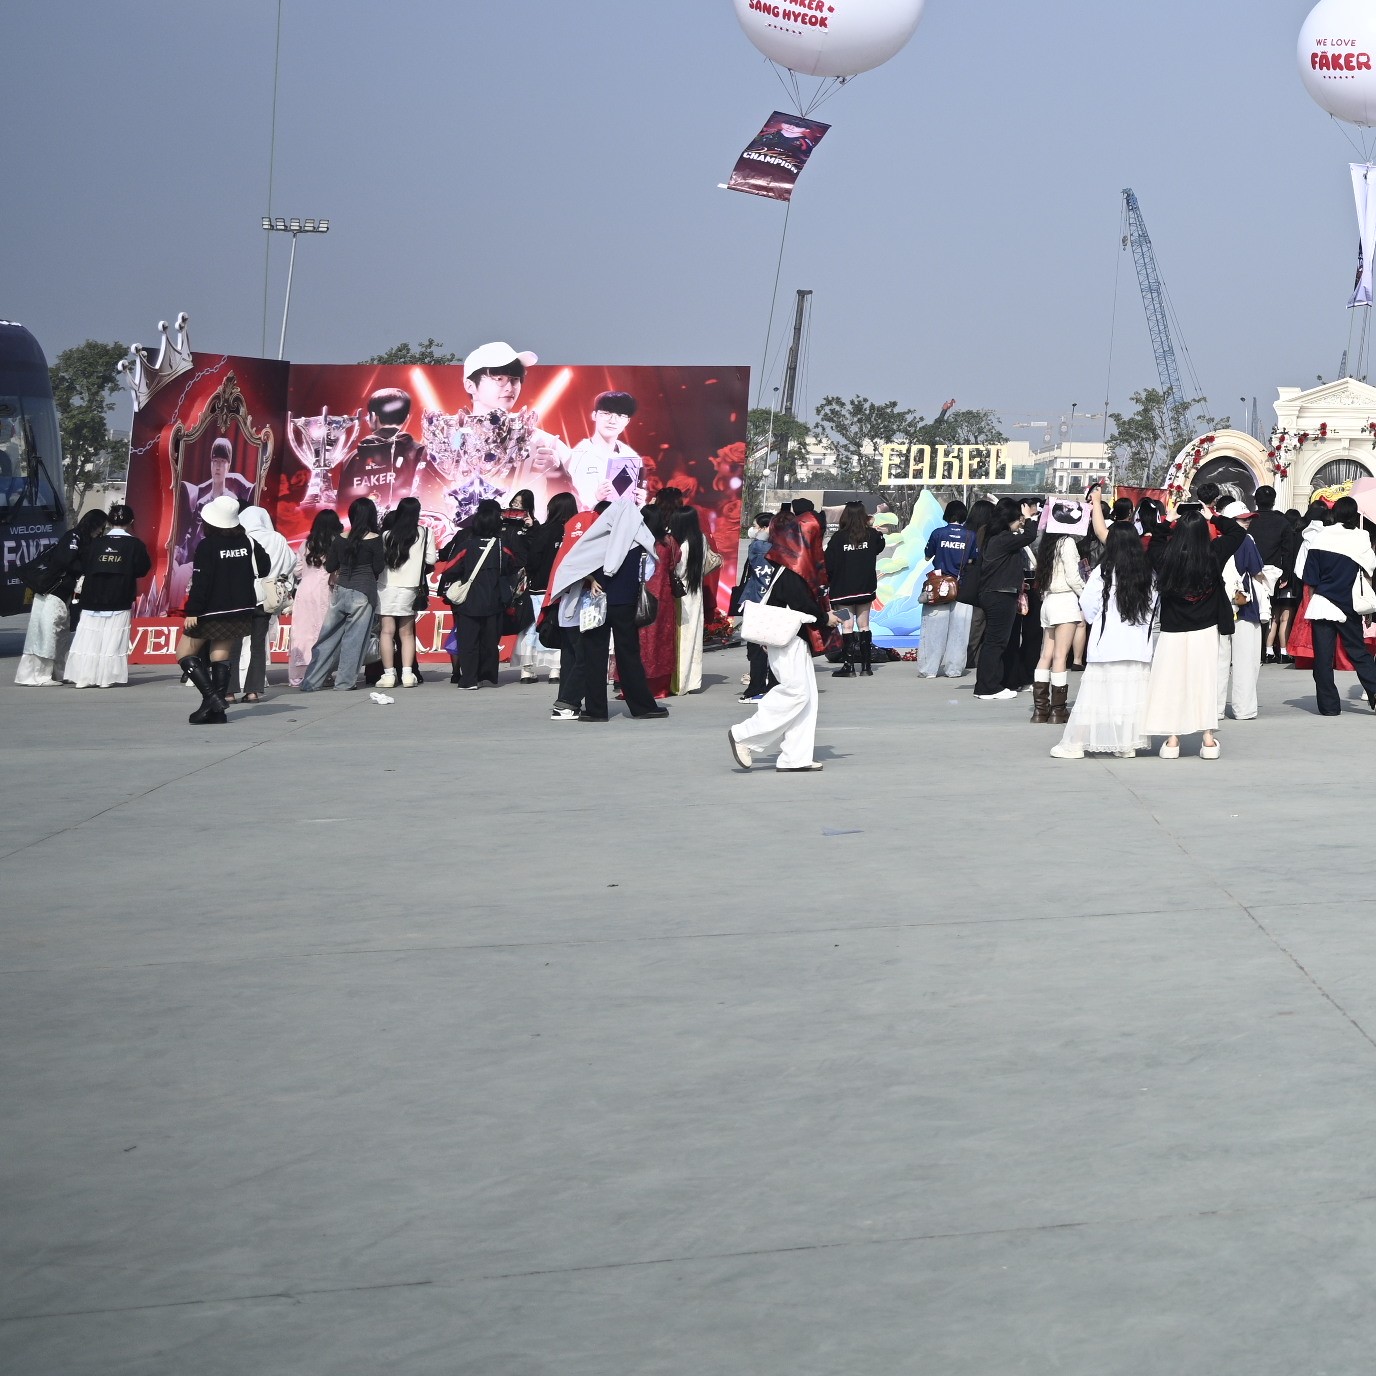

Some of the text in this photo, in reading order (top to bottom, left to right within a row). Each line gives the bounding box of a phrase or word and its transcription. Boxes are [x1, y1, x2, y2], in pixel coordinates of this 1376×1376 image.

[782, 8, 828, 29] HYEOK
[1315, 38, 1357, 47] WE LOVE
[1310, 52, 1372, 71] FAKER
[743, 152, 798, 173] CHAMPION
[878, 444, 1013, 485] FAKER
[353, 472, 396, 488] FAKER
[10, 524, 53, 535] WELCOME
[220, 548, 248, 559] FAKER
[941, 540, 966, 550] FAKER
[3, 538, 60, 572] FAK
